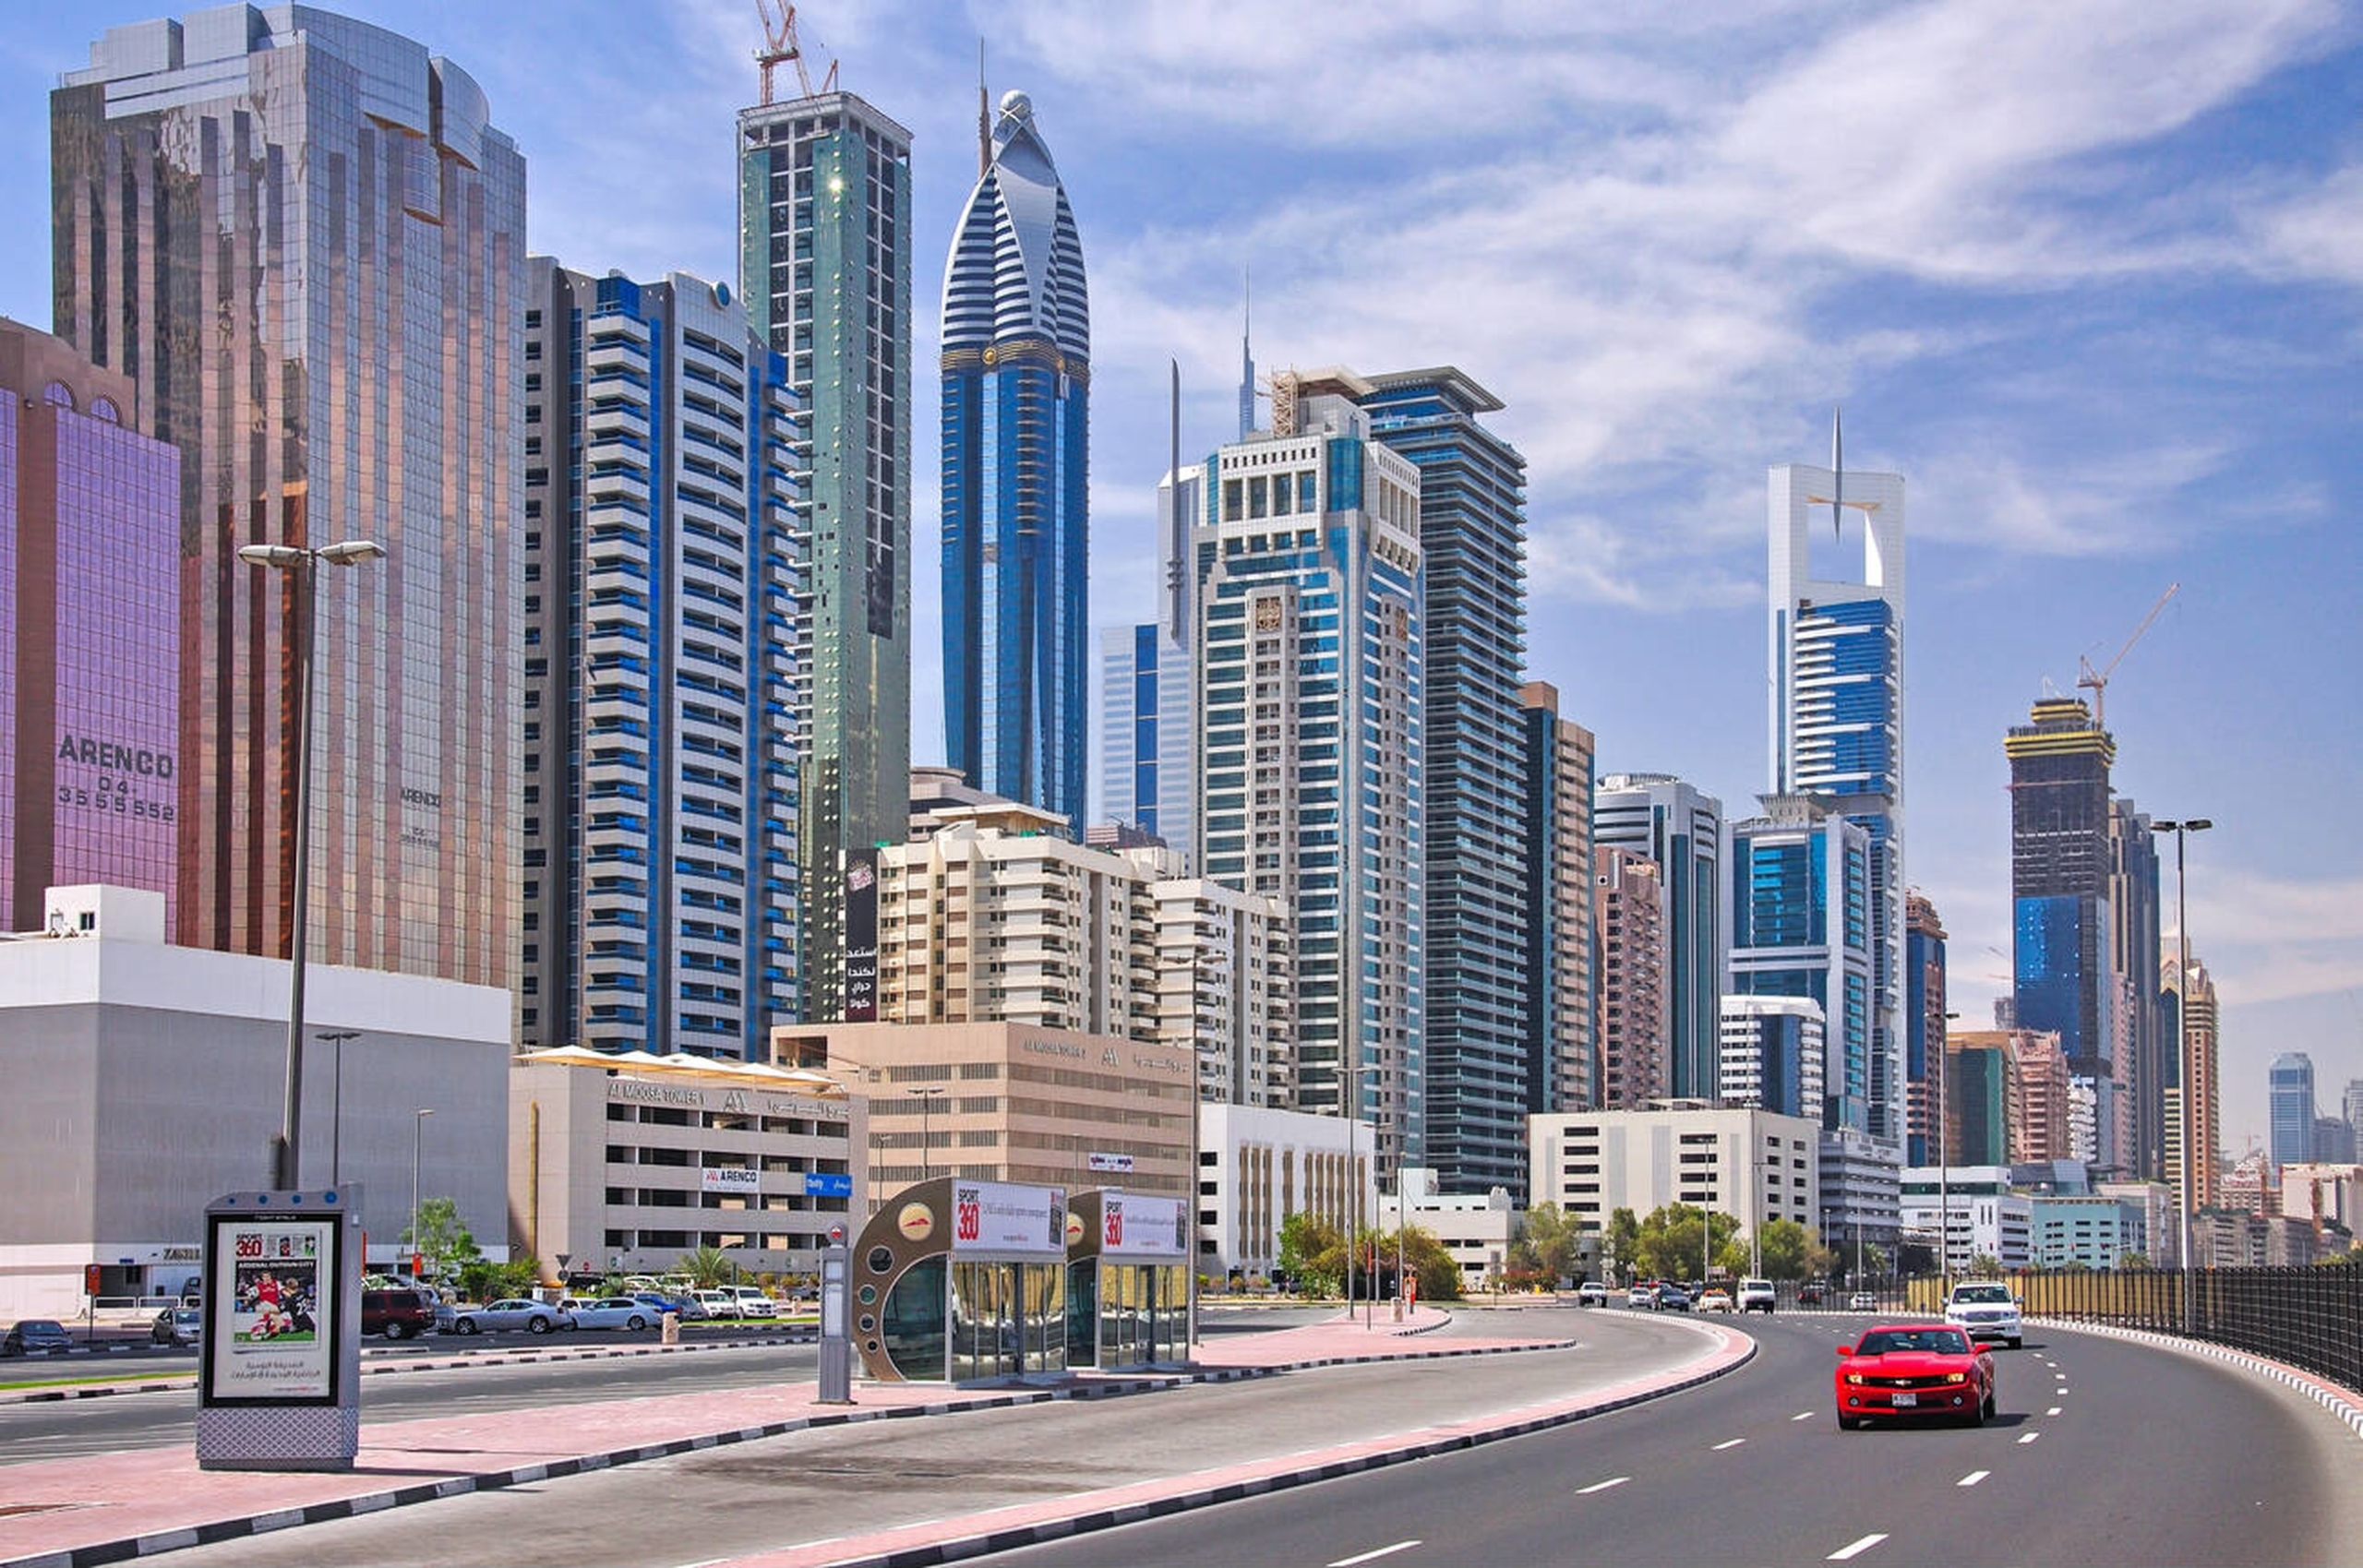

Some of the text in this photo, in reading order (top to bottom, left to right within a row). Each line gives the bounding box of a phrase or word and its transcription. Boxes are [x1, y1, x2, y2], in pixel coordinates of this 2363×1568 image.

[58, 736, 173, 778] ARENCO
[664, 1089, 699, 1104] TOWER
[719, 1170, 757, 1182] ARENCO
[958, 1189, 978, 1203] SPORT
[1106, 1201, 1122, 1213] SPORT
[958, 1203, 980, 1240] 360
[1105, 1213, 1122, 1246] 360
[235, 1239, 262, 1257] 360
